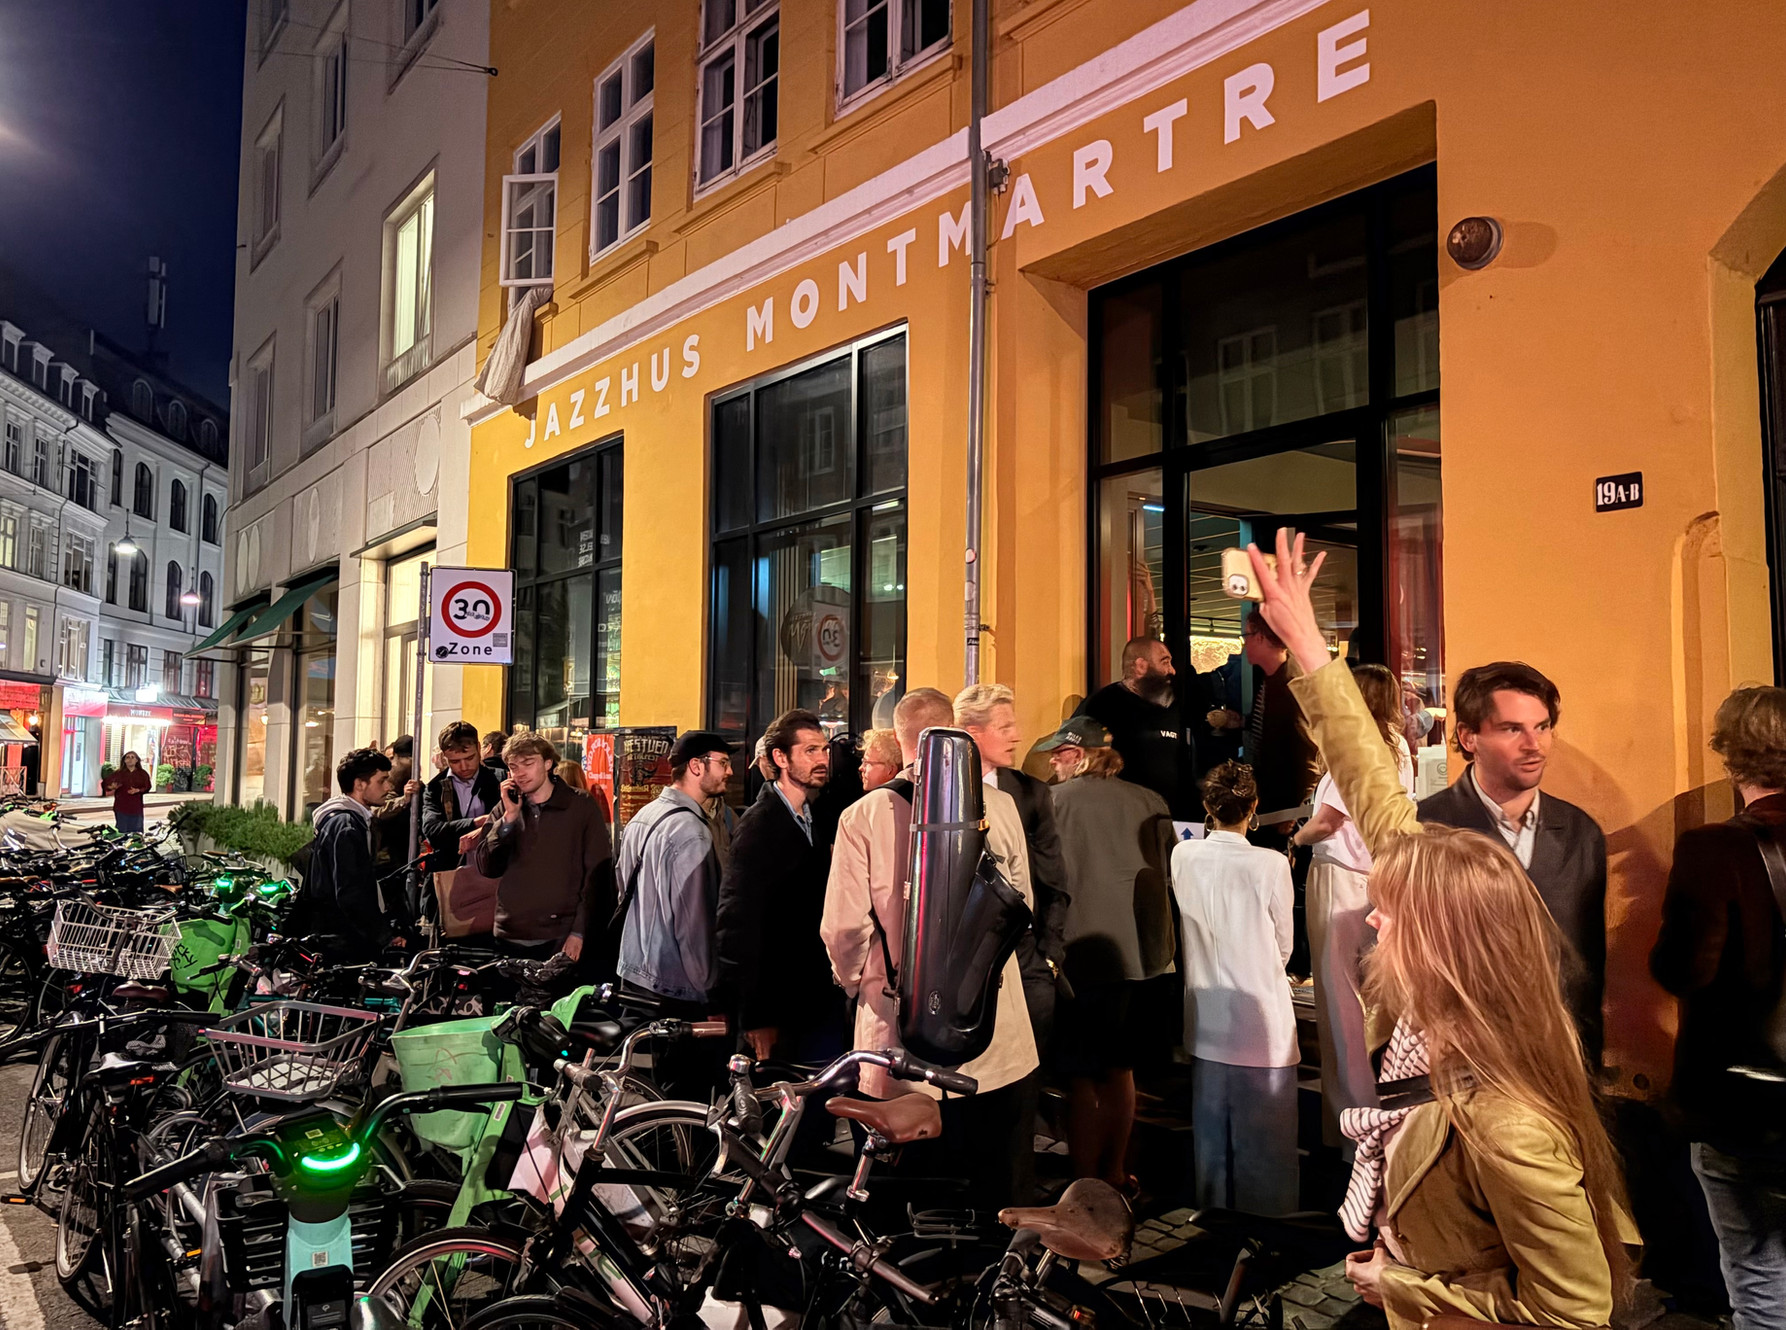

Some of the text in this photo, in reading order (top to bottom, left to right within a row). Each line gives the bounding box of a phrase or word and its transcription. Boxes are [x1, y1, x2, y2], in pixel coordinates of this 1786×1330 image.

[524, 9, 1371, 449] JAZZHUS MONTMARTRE
[1597, 481, 1640, 506] 19A-B
[453, 598, 491, 620] 30
[448, 642, 493, 656] Zone
[1160, 730, 1178, 740] VAGT
